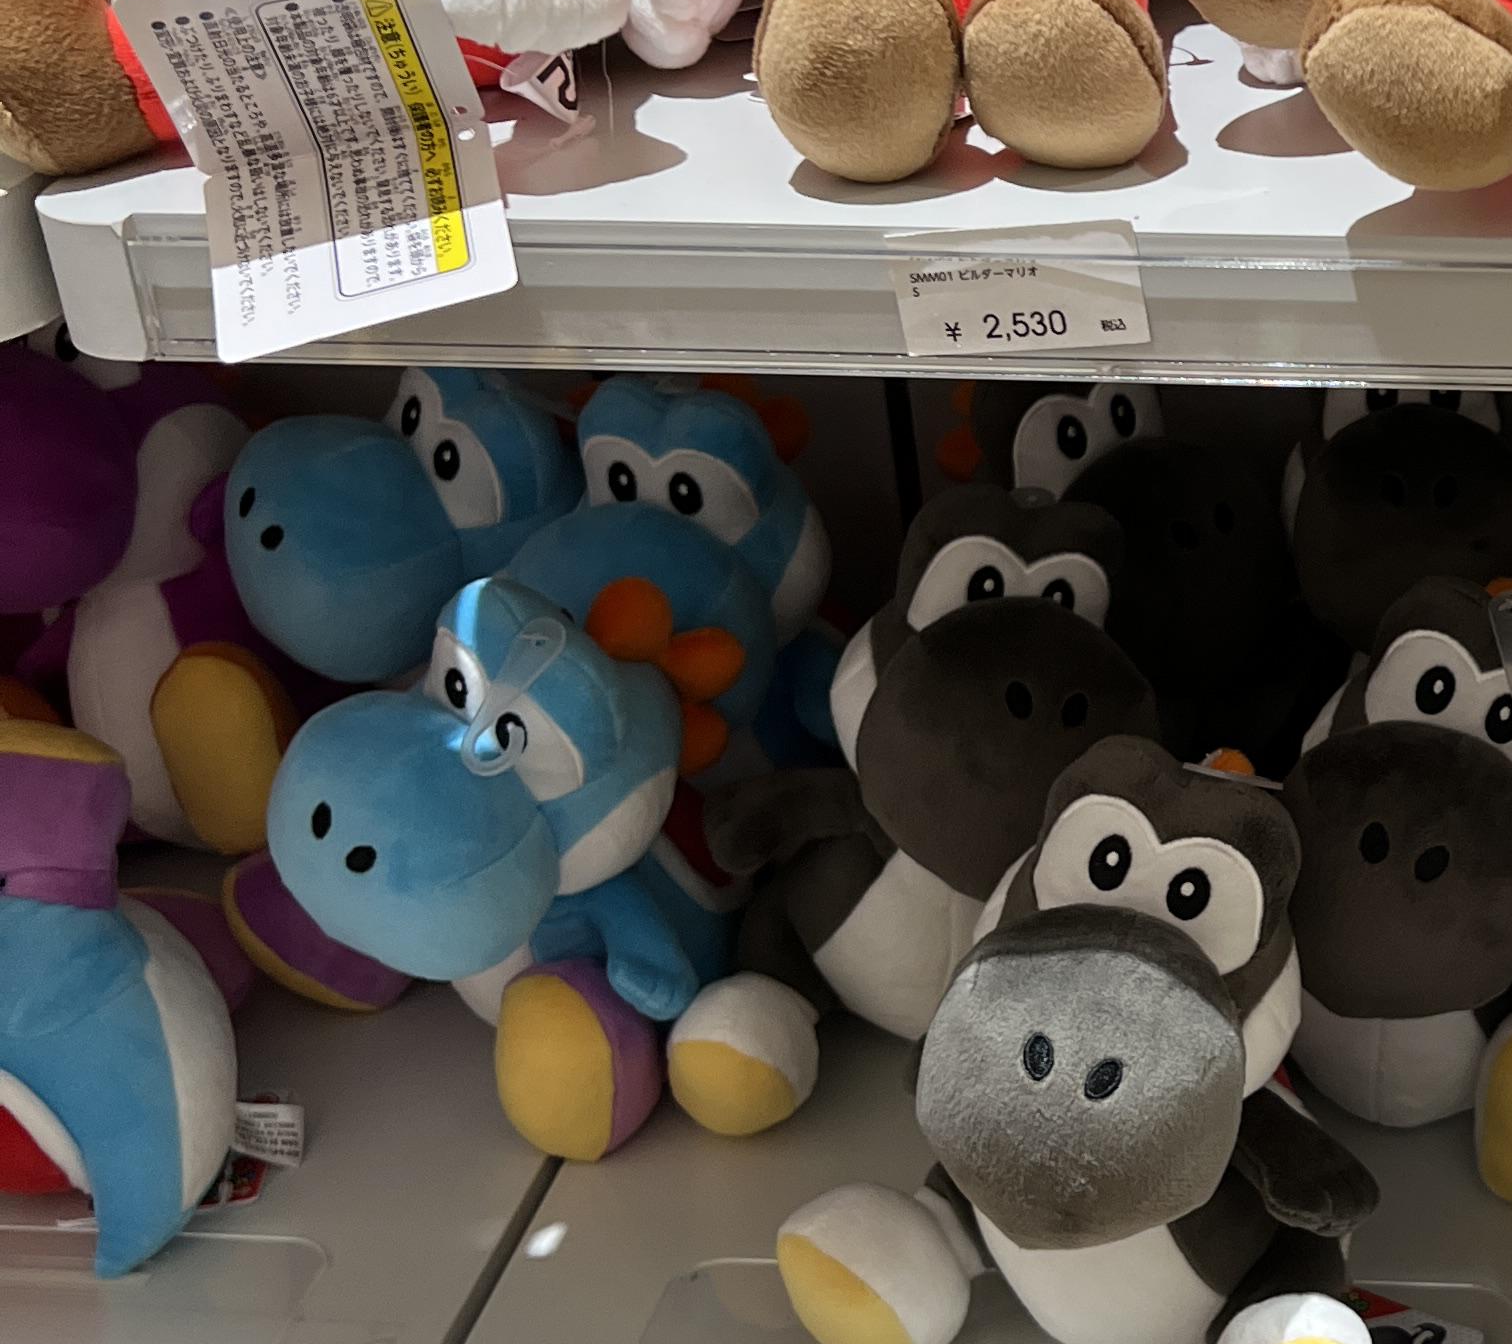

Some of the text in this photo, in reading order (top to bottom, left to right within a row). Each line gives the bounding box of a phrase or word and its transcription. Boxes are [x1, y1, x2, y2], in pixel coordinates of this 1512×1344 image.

[909, 268, 1038, 283] SMM01 ビルダーマリオ
[912, 288, 920, 297] S
[945, 322, 962, 341] ¥
[983, 310, 1067, 341] 2,530
